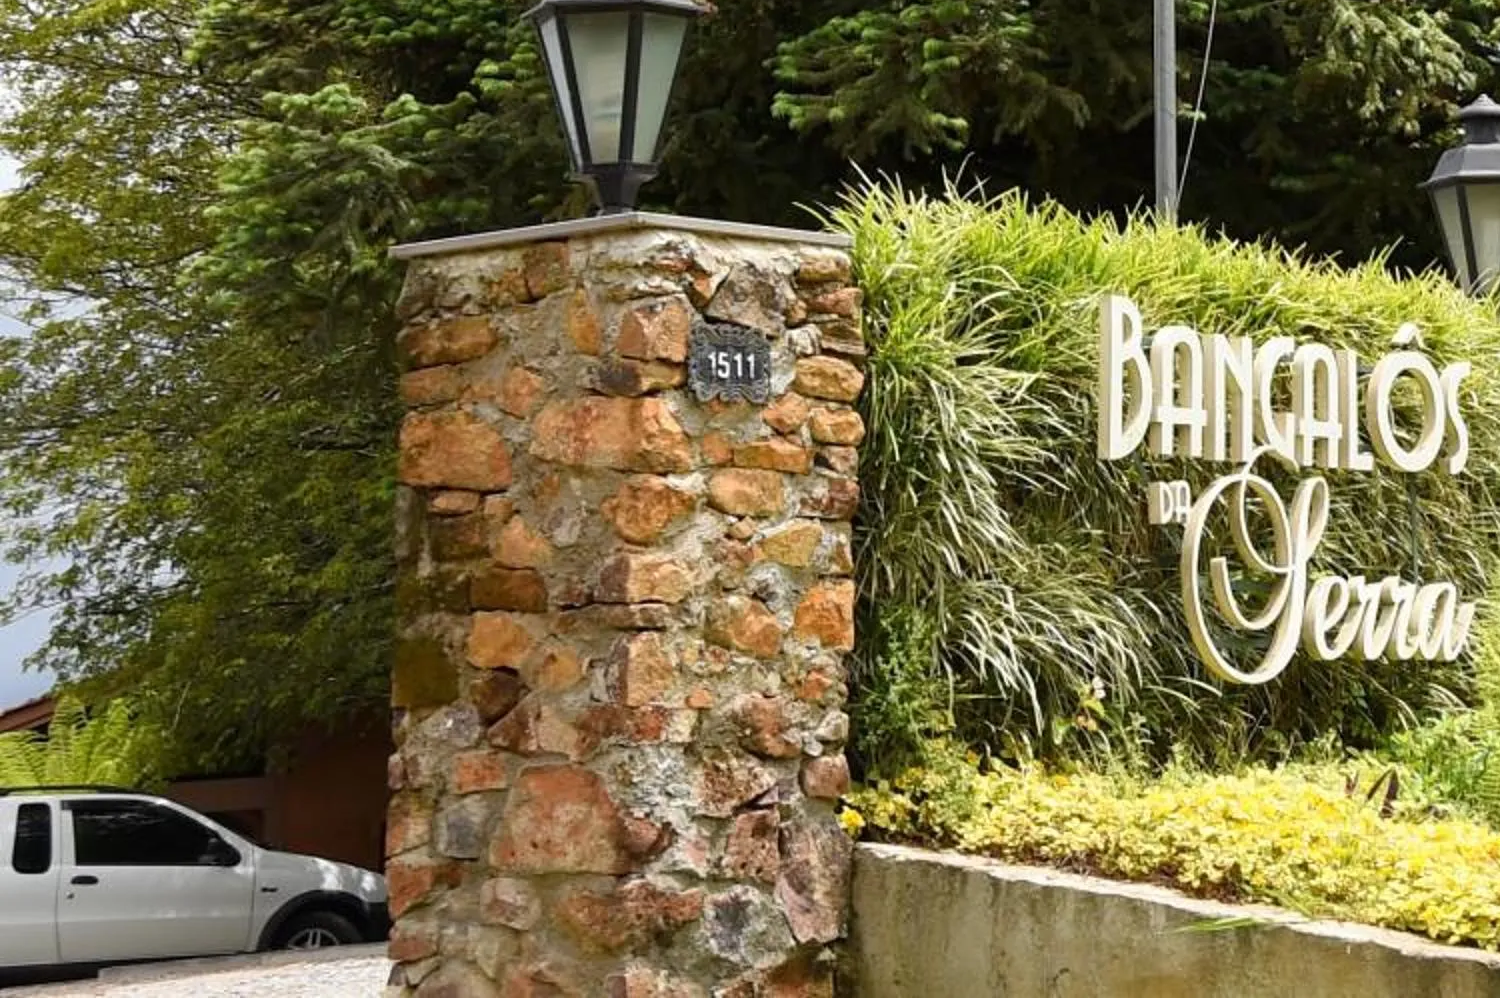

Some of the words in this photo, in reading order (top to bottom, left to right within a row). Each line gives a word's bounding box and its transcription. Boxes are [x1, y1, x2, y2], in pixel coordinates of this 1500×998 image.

[708, 351, 755, 379] 1511
[1098, 294, 1471, 475] BANGALÔS
[1148, 481, 1190, 524] DA
[1182, 445, 1475, 684] Serra
